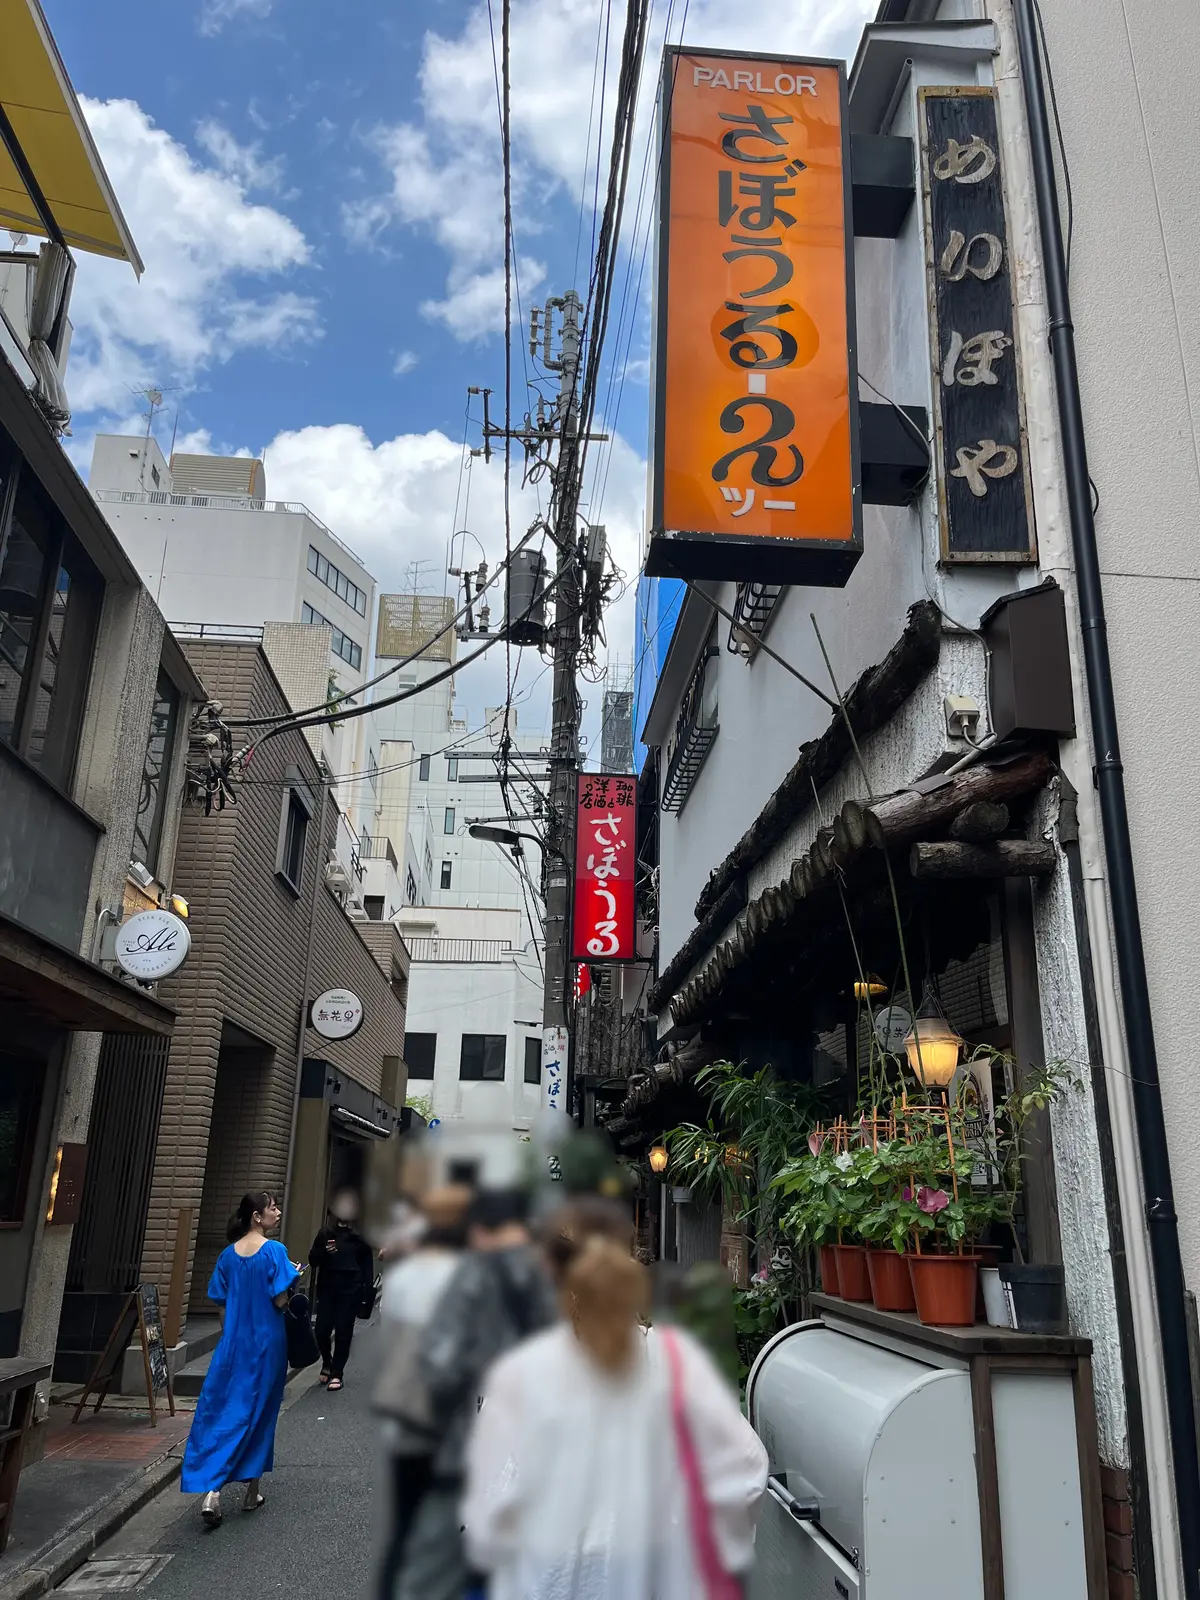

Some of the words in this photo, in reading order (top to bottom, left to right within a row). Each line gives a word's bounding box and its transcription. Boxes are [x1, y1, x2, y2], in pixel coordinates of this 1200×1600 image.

[693, 66, 818, 97] PARLOR
[586, 812, 627, 956] さぼうる
[126, 926, 178, 952] Ale
[317, 1009, 354, 1023] 無花果
